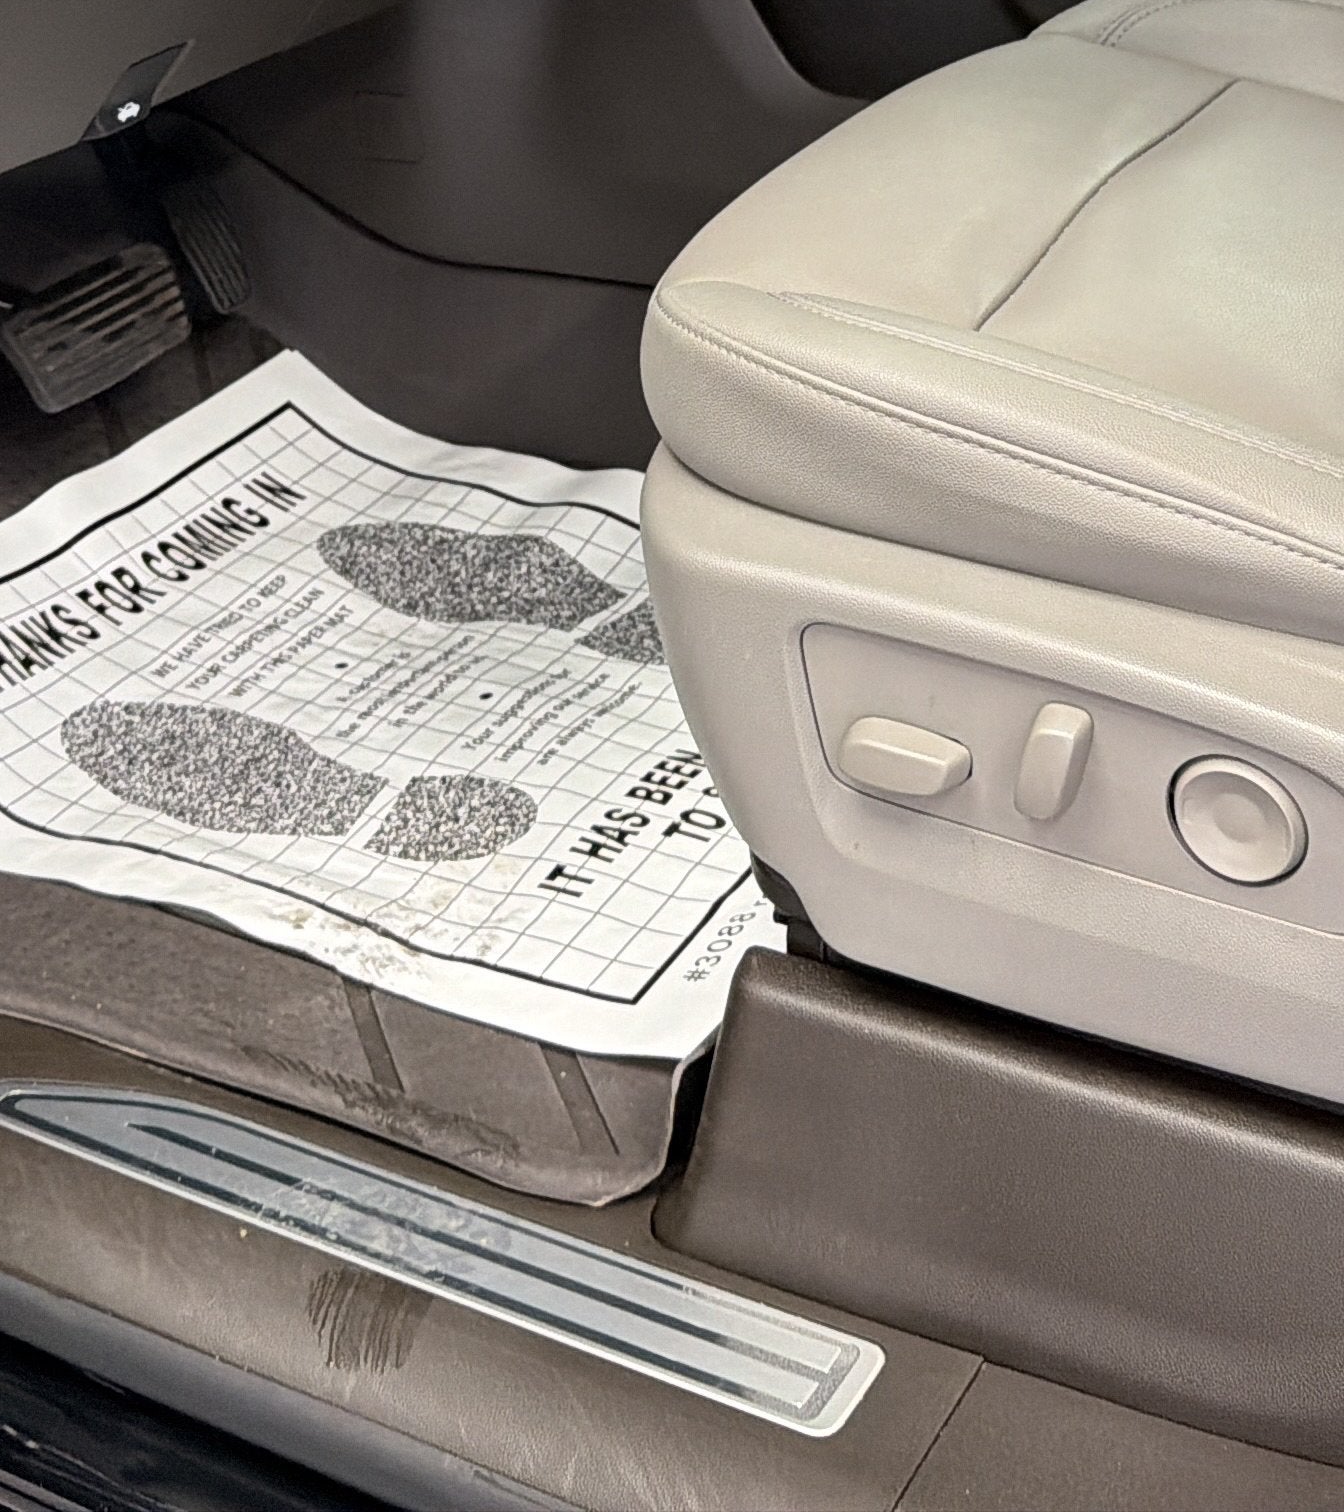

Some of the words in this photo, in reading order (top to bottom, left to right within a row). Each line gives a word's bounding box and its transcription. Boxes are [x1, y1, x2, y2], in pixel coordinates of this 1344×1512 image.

[74, 566, 168, 627] FOR
[140, 496, 271, 583] COMING
[242, 471, 308, 513] IN
[151, 659, 179, 679] WE
[175, 632, 209, 662] HAVE
[204, 611, 244, 639] TRIED
[239, 597, 262, 614] TO
[257, 574, 287, 599] KEEP
[184, 662, 227, 691] YOUR
[221, 616, 289, 664] CARPETING
[284, 587, 325, 620] CLEAN
[227, 670, 267, 698] WITH
[260, 651, 294, 674] THIS
[287, 625, 326, 656] PAPER
[323, 604, 355, 629] MAT
[460, 727, 495, 751] Your
[494, 711, 560, 763] improving
[536, 747, 560, 766] are
[536, 862, 596, 899] IT
[568, 807, 652, 864] HAS
[623, 747, 708, 807] BEEN
[660, 807, 727, 844] TO
[681, 910, 758, 984] #3088
